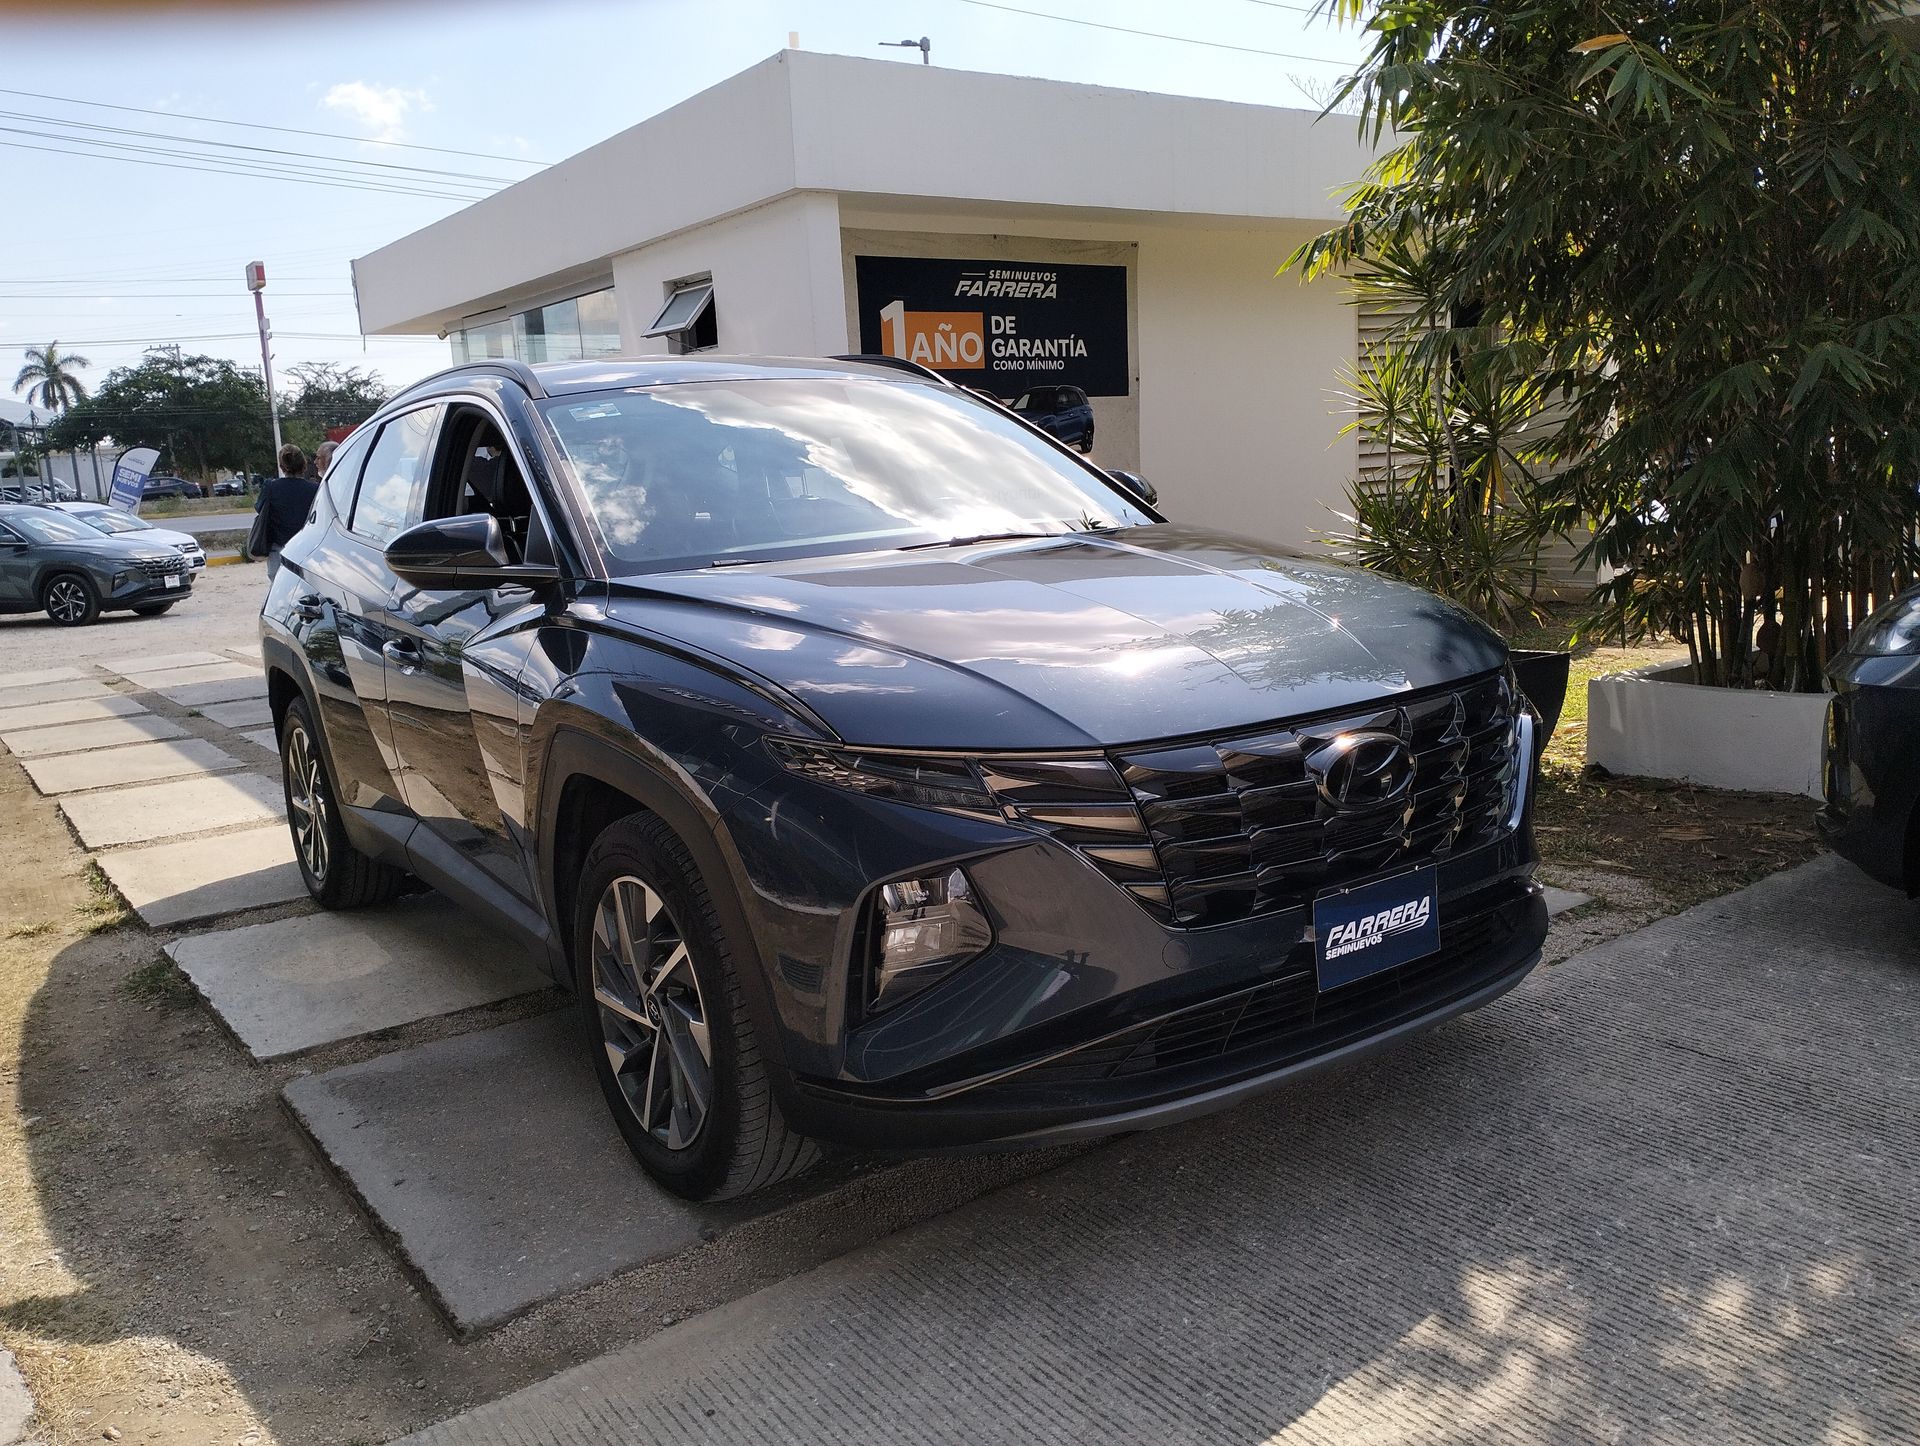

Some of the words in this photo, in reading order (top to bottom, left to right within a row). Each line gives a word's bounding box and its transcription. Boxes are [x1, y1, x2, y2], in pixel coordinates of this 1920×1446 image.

[989, 270, 1056, 281] SEMINUEVOS
[954, 280, 1057, 299] FARRERA
[880, 300, 904, 361] 1
[910, 323, 983, 362] AÑO
[991, 316, 1016, 334] DE
[991, 334, 1087, 357] GARANTÍA
[992, 360, 1024, 371] COMO
[1027, 357, 1065, 370] MÍNIMO
[118, 468, 142, 483] SEMI
[1325, 896, 1430, 948] FARRERA
[1325, 934, 1383, 960] SEMINUEVOS
